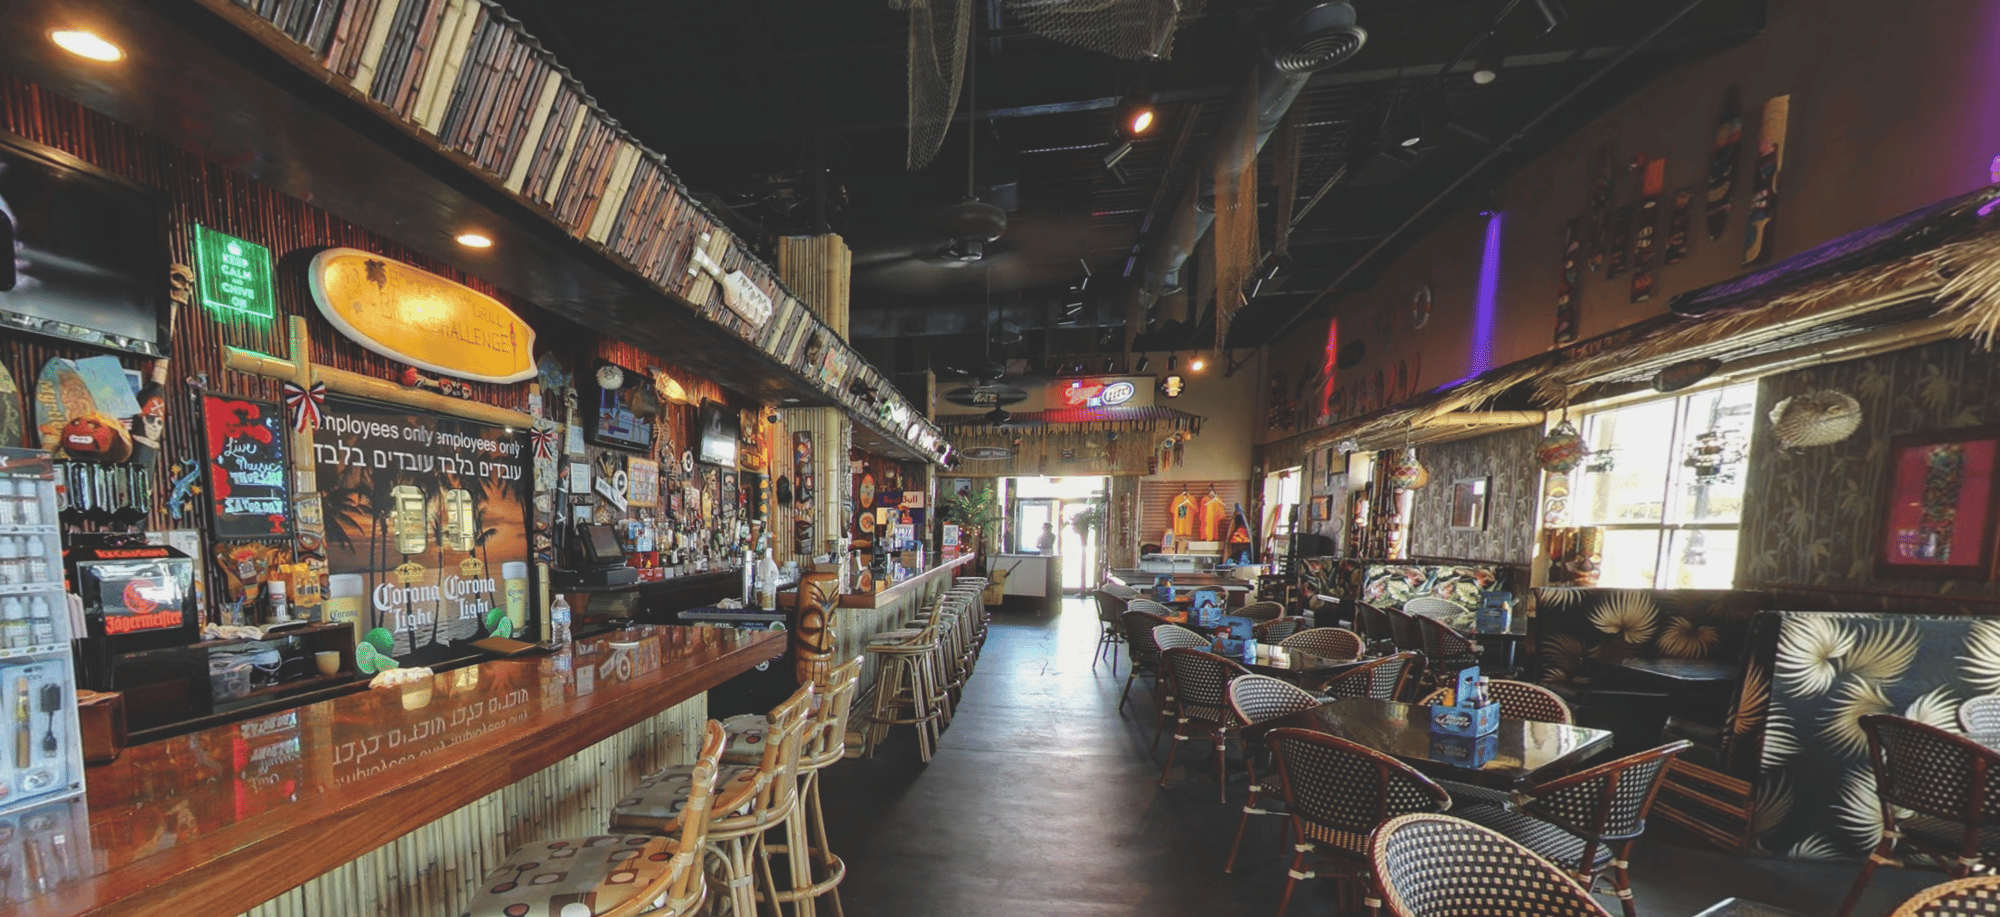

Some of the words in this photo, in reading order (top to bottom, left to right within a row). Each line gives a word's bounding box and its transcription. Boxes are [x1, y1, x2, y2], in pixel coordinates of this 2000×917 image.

[312, 414, 400, 440] mployees
[223, 436, 258, 457] Live
[313, 439, 367, 467] בלבד
[373, 449, 434, 473] עובדים
[437, 453, 475, 476] בלבד
[479, 461, 522, 481] עובדים
[373, 582, 441, 613] Corona
[444, 574, 496, 602] Corona
[393, 607, 432, 633] Light
[458, 597, 490, 620] Light
